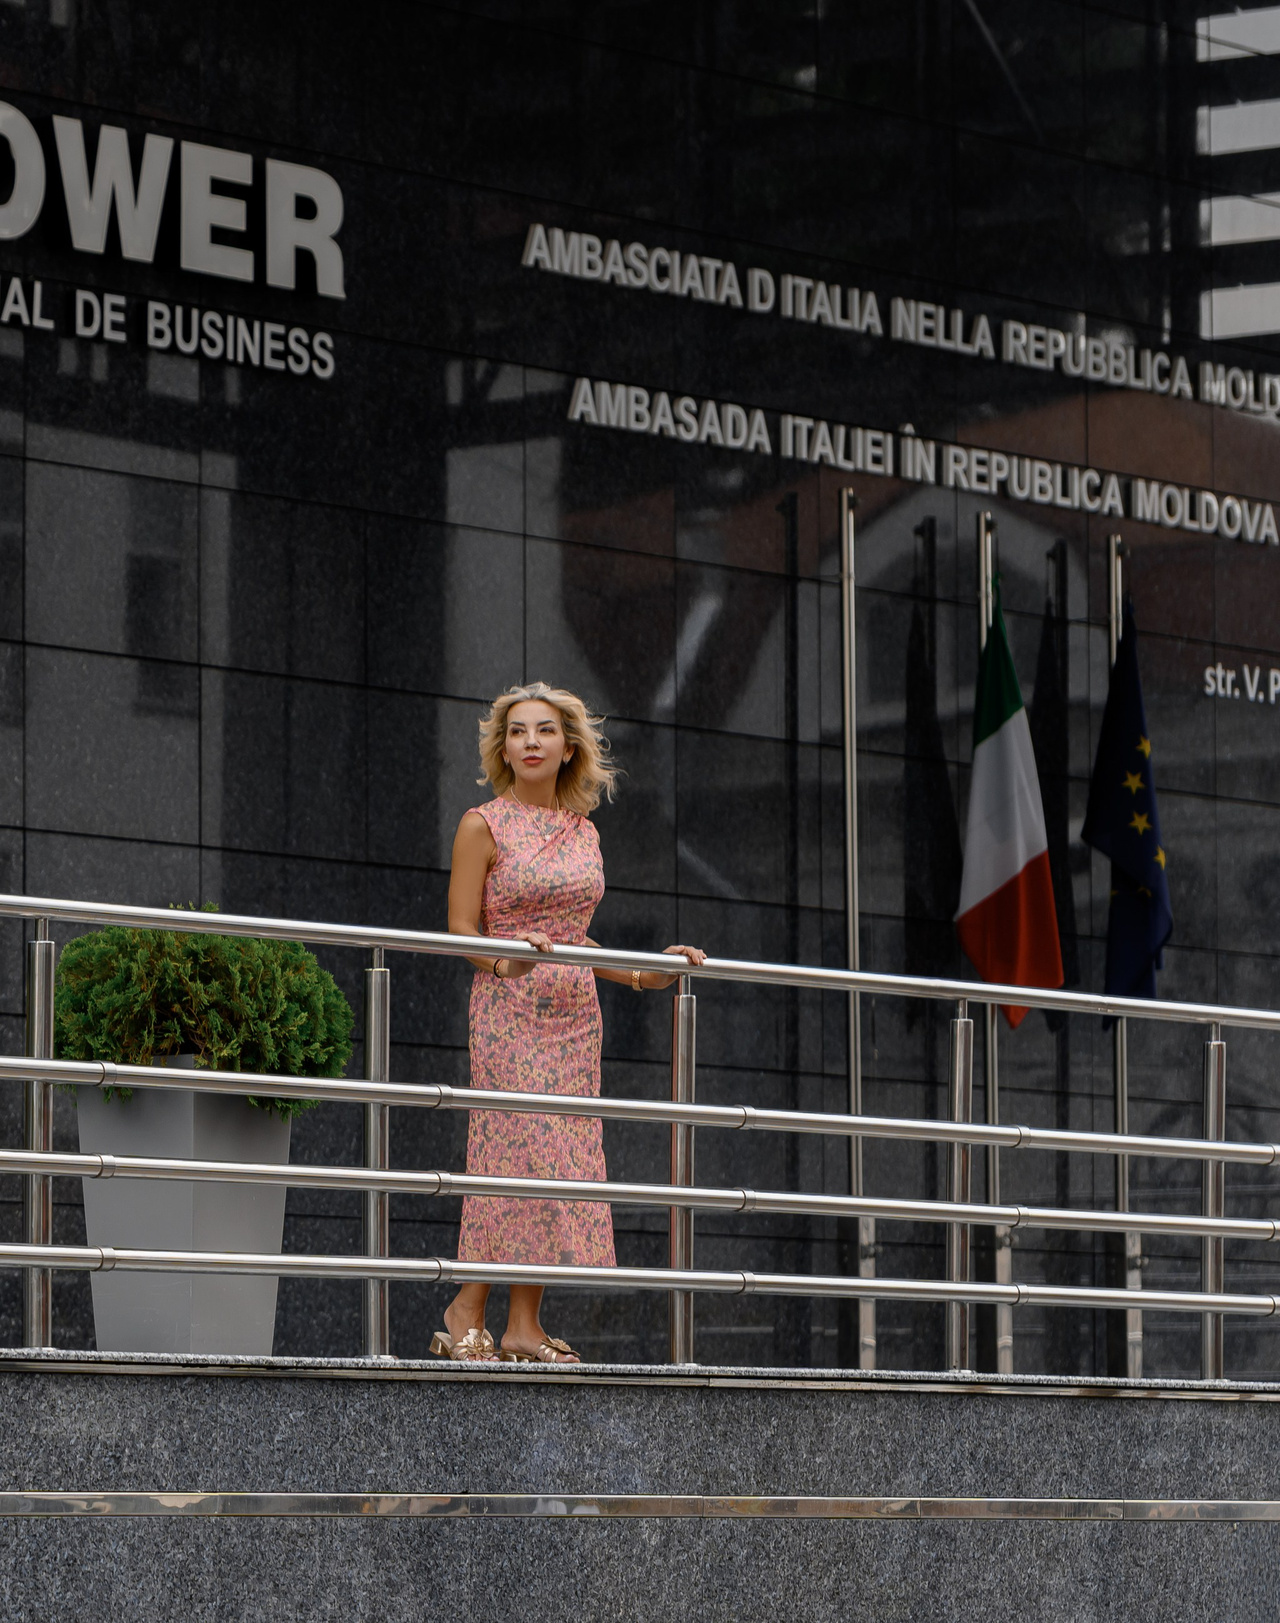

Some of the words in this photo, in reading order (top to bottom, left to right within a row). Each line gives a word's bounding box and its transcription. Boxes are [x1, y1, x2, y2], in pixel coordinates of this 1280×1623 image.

[75, 289, 128, 343] DE
[147, 300, 337, 380] BUSINESS
[521, 223, 744, 308] AMBASCIATA
[781, 273, 883, 336] ITALIA
[890, 296, 996, 359] NELLA
[1002, 319, 1194, 400] REPUBBLICA
[567, 377, 773, 455] AMBASADA
[780, 413, 894, 476] ITALIEI
[899, 422, 936, 485] ÎN
[942, 443, 1125, 518] REPUBLICA
[1131, 477, 1280, 546] MOLDOVA
[1204, 661, 1240, 699] str.
[1242, 663, 1265, 703] V.
